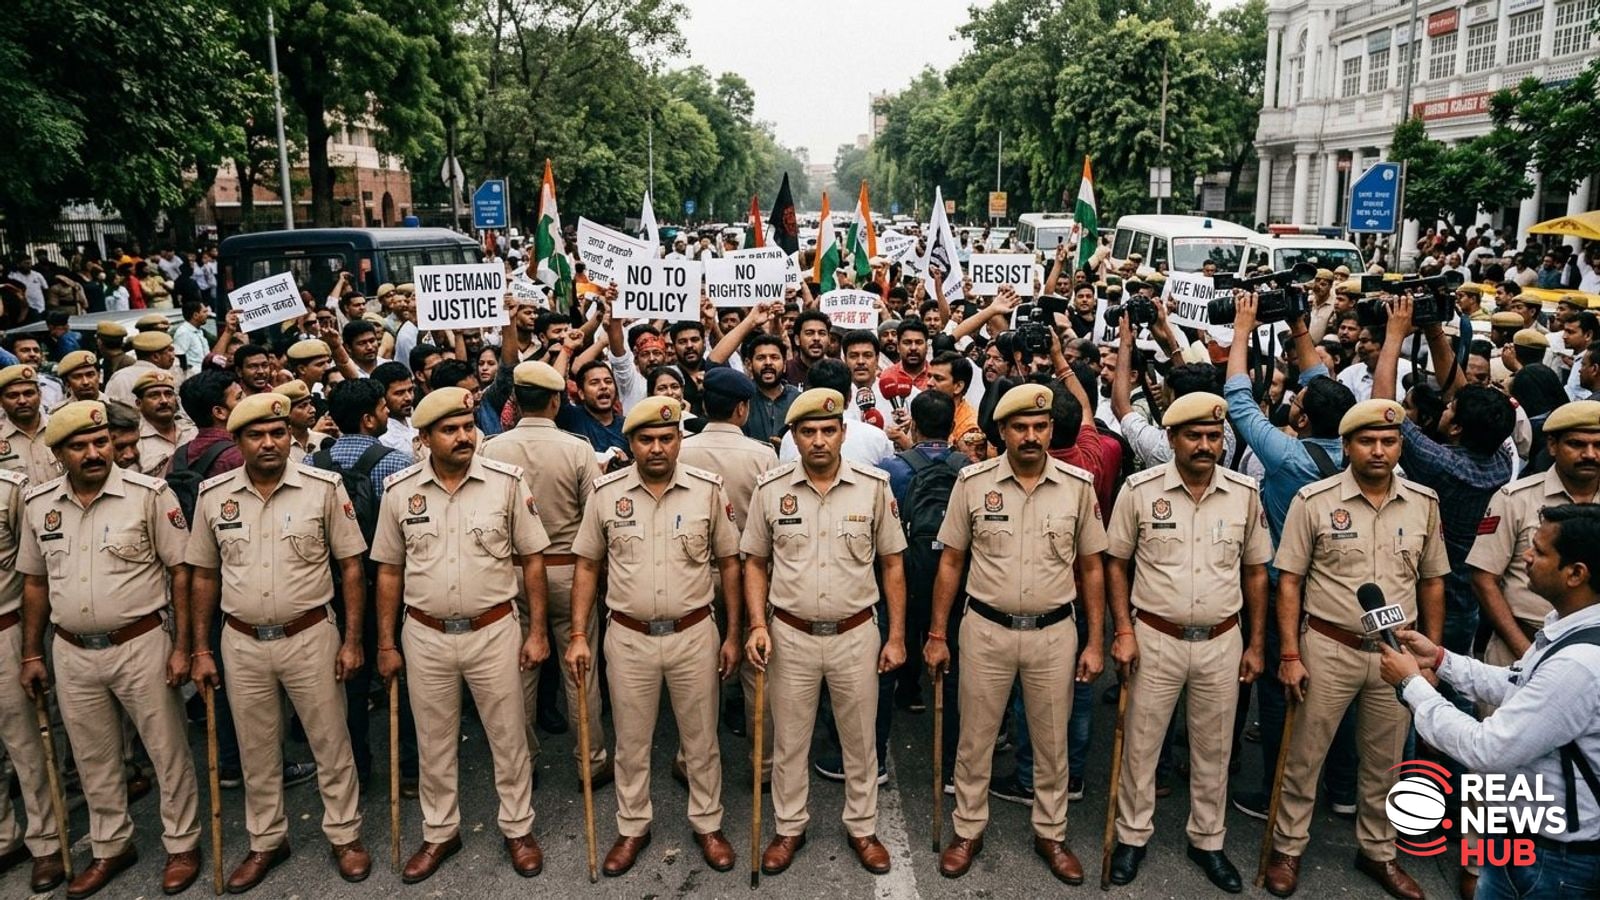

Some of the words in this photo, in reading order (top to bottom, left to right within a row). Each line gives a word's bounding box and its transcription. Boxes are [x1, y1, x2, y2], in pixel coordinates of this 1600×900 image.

[627, 265, 652, 286] NO
[663, 267, 686, 287] TO
[735, 264, 756, 280] NO
[973, 264, 1031, 284] RESIST
[419, 274, 442, 293] WE
[445, 272, 502, 292] DEMAND
[709, 284, 752, 298] RIGHTS
[755, 284, 783, 298] NOW
[428, 297, 498, 321] JUSTICE
[625, 291, 688, 313] POLICY
[1380, 607, 1402, 625] ANI
